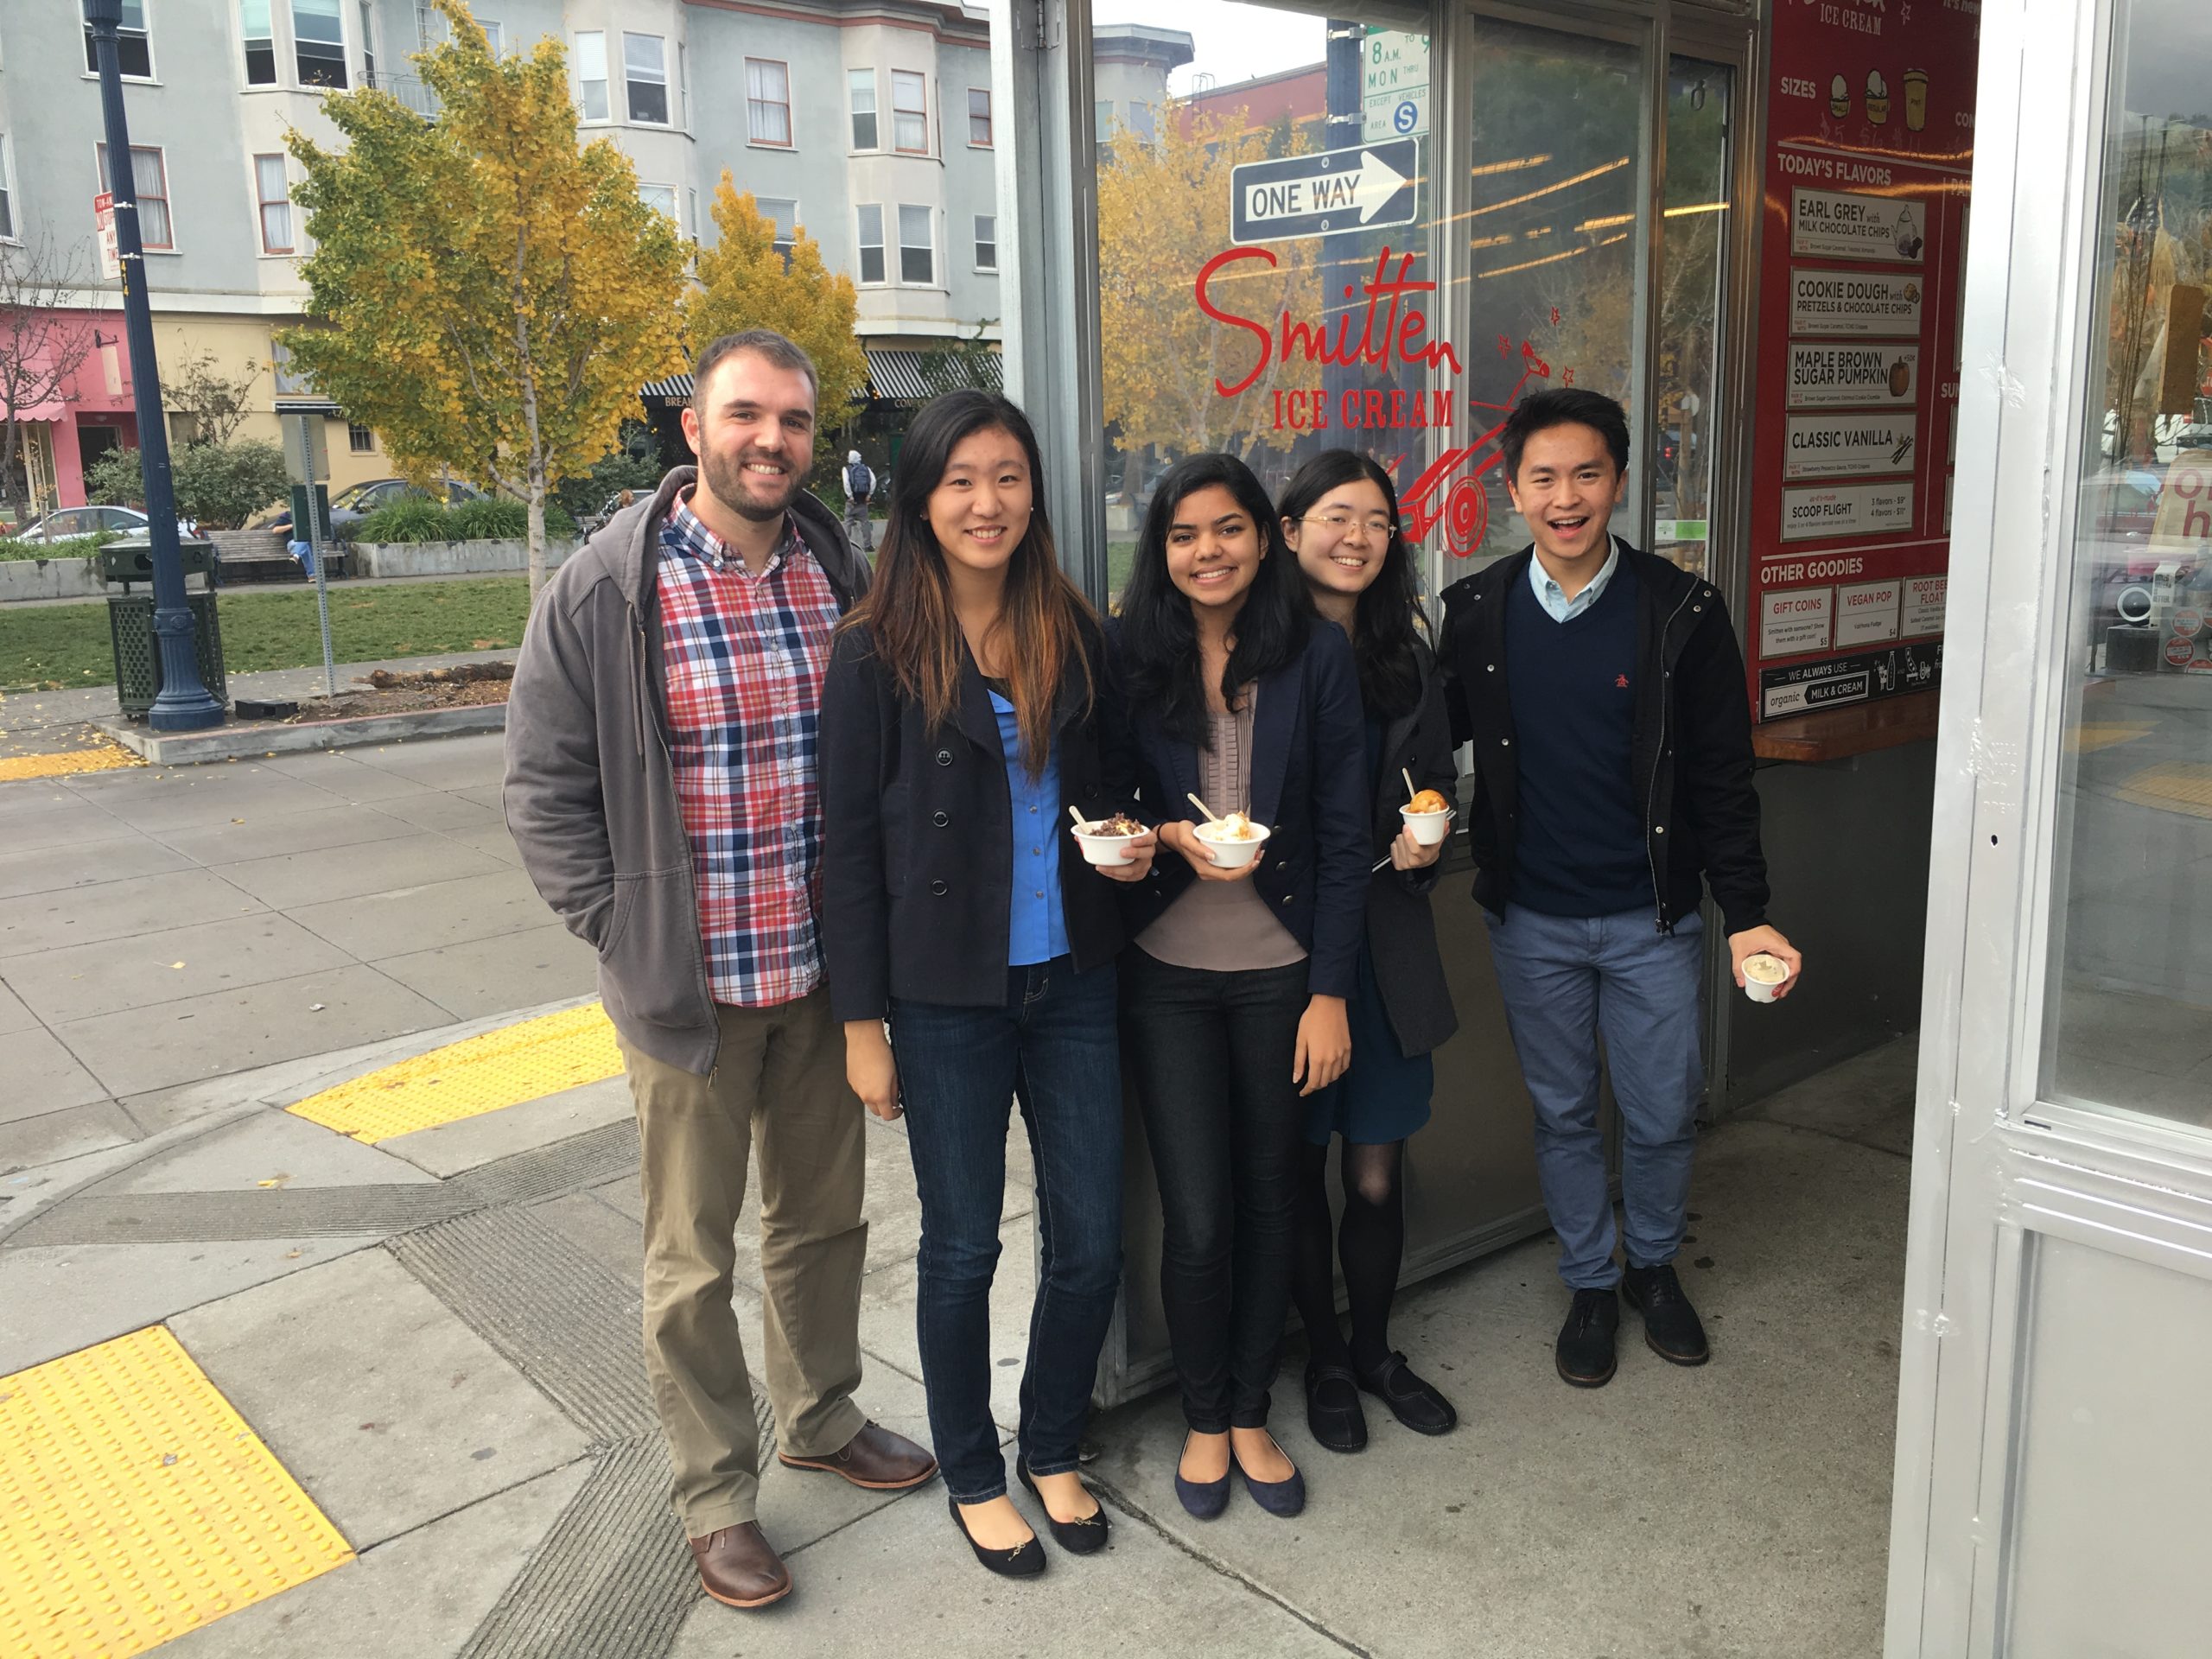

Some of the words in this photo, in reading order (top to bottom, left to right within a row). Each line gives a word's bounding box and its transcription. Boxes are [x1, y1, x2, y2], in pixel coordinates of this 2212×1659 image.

[1820, 3, 1840, 25] ICE
[1842, 9, 1882, 35] CREAM
[1372, 41, 1382, 65] 8
[1384, 48, 1402, 63] A.M.
[1405, 35, 1415, 44] TO
[1368, 68, 1398, 89] MON
[1403, 64, 1419, 75] THRU
[1781, 76, 1816, 99] SIZES
[1370, 96, 1392, 108] EXCEPT
[1398, 88, 1427, 102] VEHICLES
[1370, 120, 1386, 130] AREA
[1398, 105, 1414, 130] S
[1777, 153, 1833, 179] TODAY'S
[1836, 162, 1892, 186] FLAVORS
[1253, 184, 1302, 218] ONE
[1313, 175, 1361, 210] WAY
[1799, 199, 1830, 219] EARL
[1834, 202, 1866, 222] GREY
[1866, 212, 1880, 224] with
[1798, 219, 1817, 233] MILK
[1819, 222, 1866, 237] CHOCOLATE
[1867, 226, 1890, 238] CHIPS
[1797, 280, 1844, 299] COOKIE
[1847, 283, 1889, 300] DOUGH
[1890, 290, 1903, 301] with
[1796, 300, 1835, 313] PRETZELS
[1837, 302, 1842, 313] &
[1844, 302, 1889, 315] CHOCOLATE
[1891, 303, 1912, 315] CHIPS
[1195, 246, 1462, 397] Smitten
[1795, 351, 1834, 368] MAPLE
[1838, 352, 1882, 368] BROWN
[1794, 368, 1834, 385] SUGAR
[1838, 368, 1888, 385] PUMPKIN
[1273, 390, 1328, 429] ICE
[1342, 390, 1453, 429] CREAM
[1792, 432, 1840, 448] CLASSIC
[1844, 429, 1892, 447] VANILLA
[1792, 505, 1821, 518] SCOOP
[1823, 503, 1852, 516] FLIGHT
[1872, 498, 1875, 506] 3
[1876, 497, 1893, 505] flavors
[1871, 508, 1875, 517] 4
[1875, 508, 1892, 517] flavors
[1761, 563, 1804, 583] OTHER
[1808, 557, 1863, 579] GOODIES
[1912, 581, 1933, 593] ROOT
[1773, 601, 1793, 614] GIFT
[1795, 599, 1821, 612] COINS
[1847, 593, 1874, 607] VEGAN
[1876, 591, 1891, 603] POP
[1920, 592, 1943, 604] FLOAT
[1821, 637, 1827, 645] $5
[1789, 670, 1802, 681] WE
[1802, 664, 1833, 679] ALWAYS
[1834, 662, 1848, 673] USE
[1770, 692, 1800, 708] organic
[1811, 687, 1829, 700] MILK
[1830, 685, 1836, 696] &
[1837, 681, 1863, 695] CREAM
